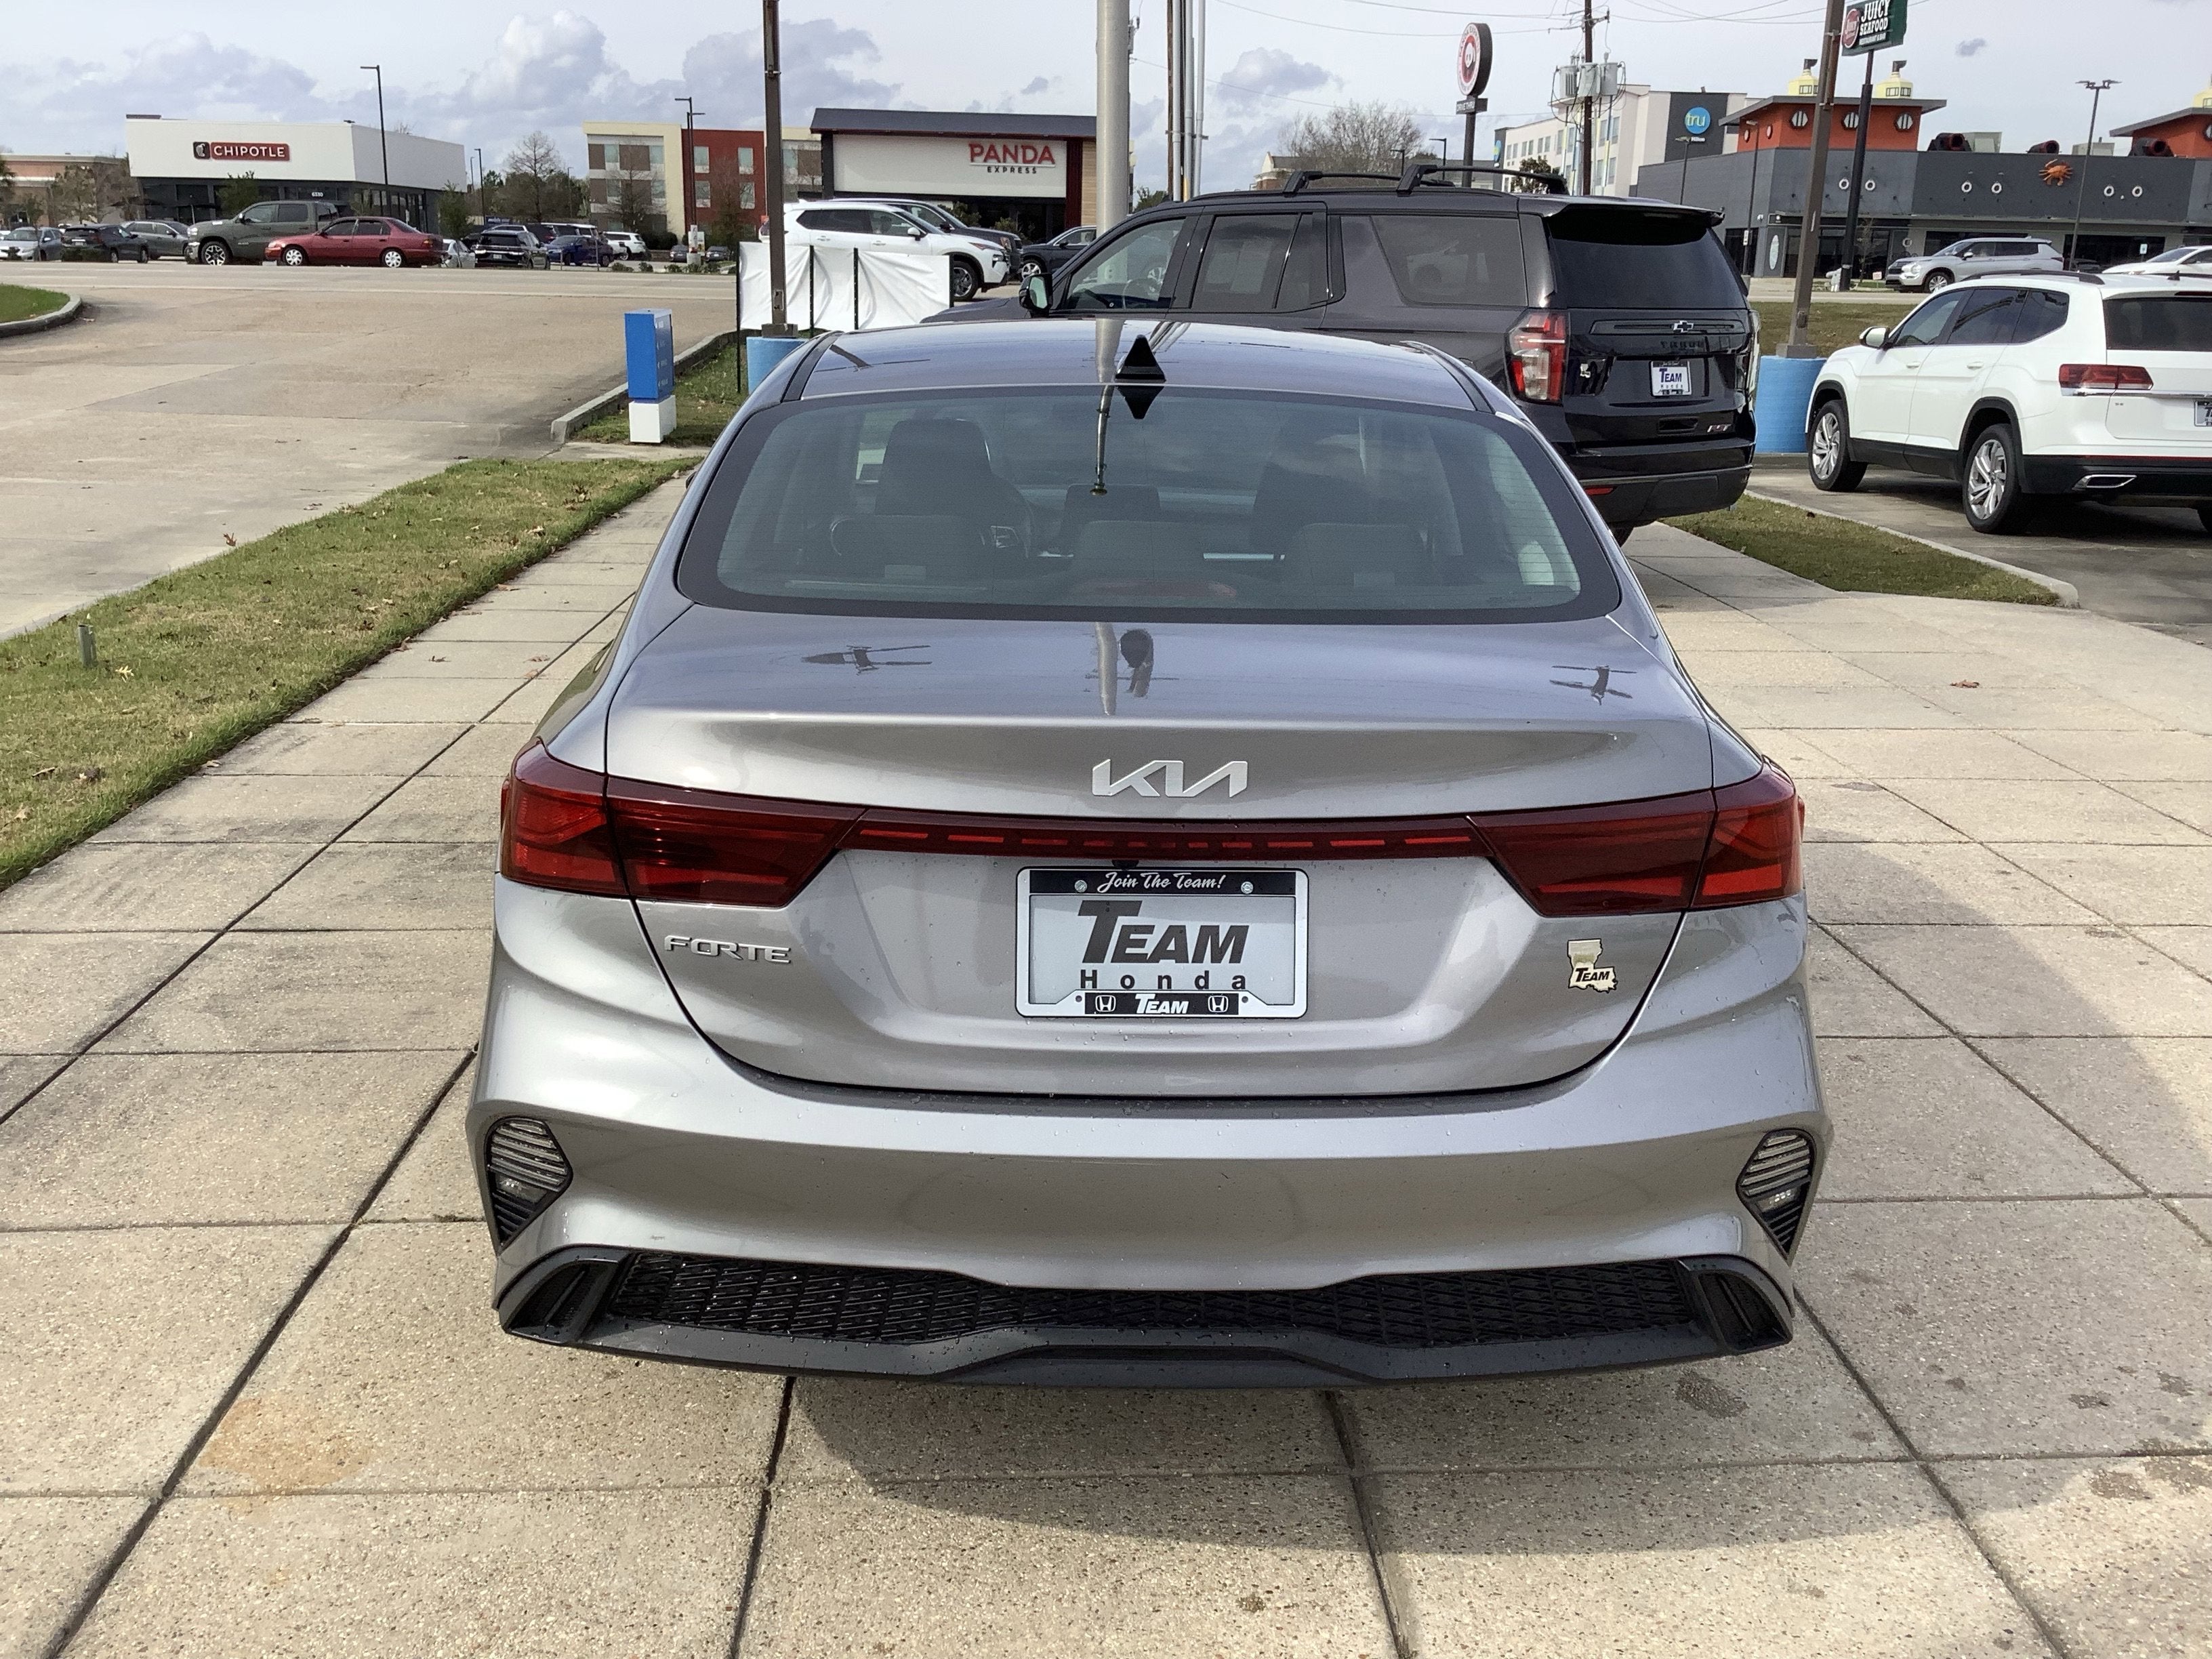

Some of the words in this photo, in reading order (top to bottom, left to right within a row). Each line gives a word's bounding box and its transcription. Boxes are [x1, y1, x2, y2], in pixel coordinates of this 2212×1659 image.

[1861, 0, 1891, 22] JUICY
[1860, 17, 1889, 36] SEAFOOD
[213, 145, 285, 157] CHIPOTLE
[968, 142, 1056, 164] PANDA
[987, 166, 1037, 174] EXPRESS
[1659, 368, 1683, 383] TEAM
[1092, 758, 1248, 798] KIA
[1097, 872, 1139, 893] Join
[1140, 872, 1172, 889] The
[1173, 872, 1227, 889] Team!
[1078, 900, 1250, 964] TEAM
[664, 935, 792, 964] FORTE
[1080, 969, 1246, 989] Honda
[1575, 967, 1610, 983] TEAM
[1134, 994, 1189, 1015] TEAM
